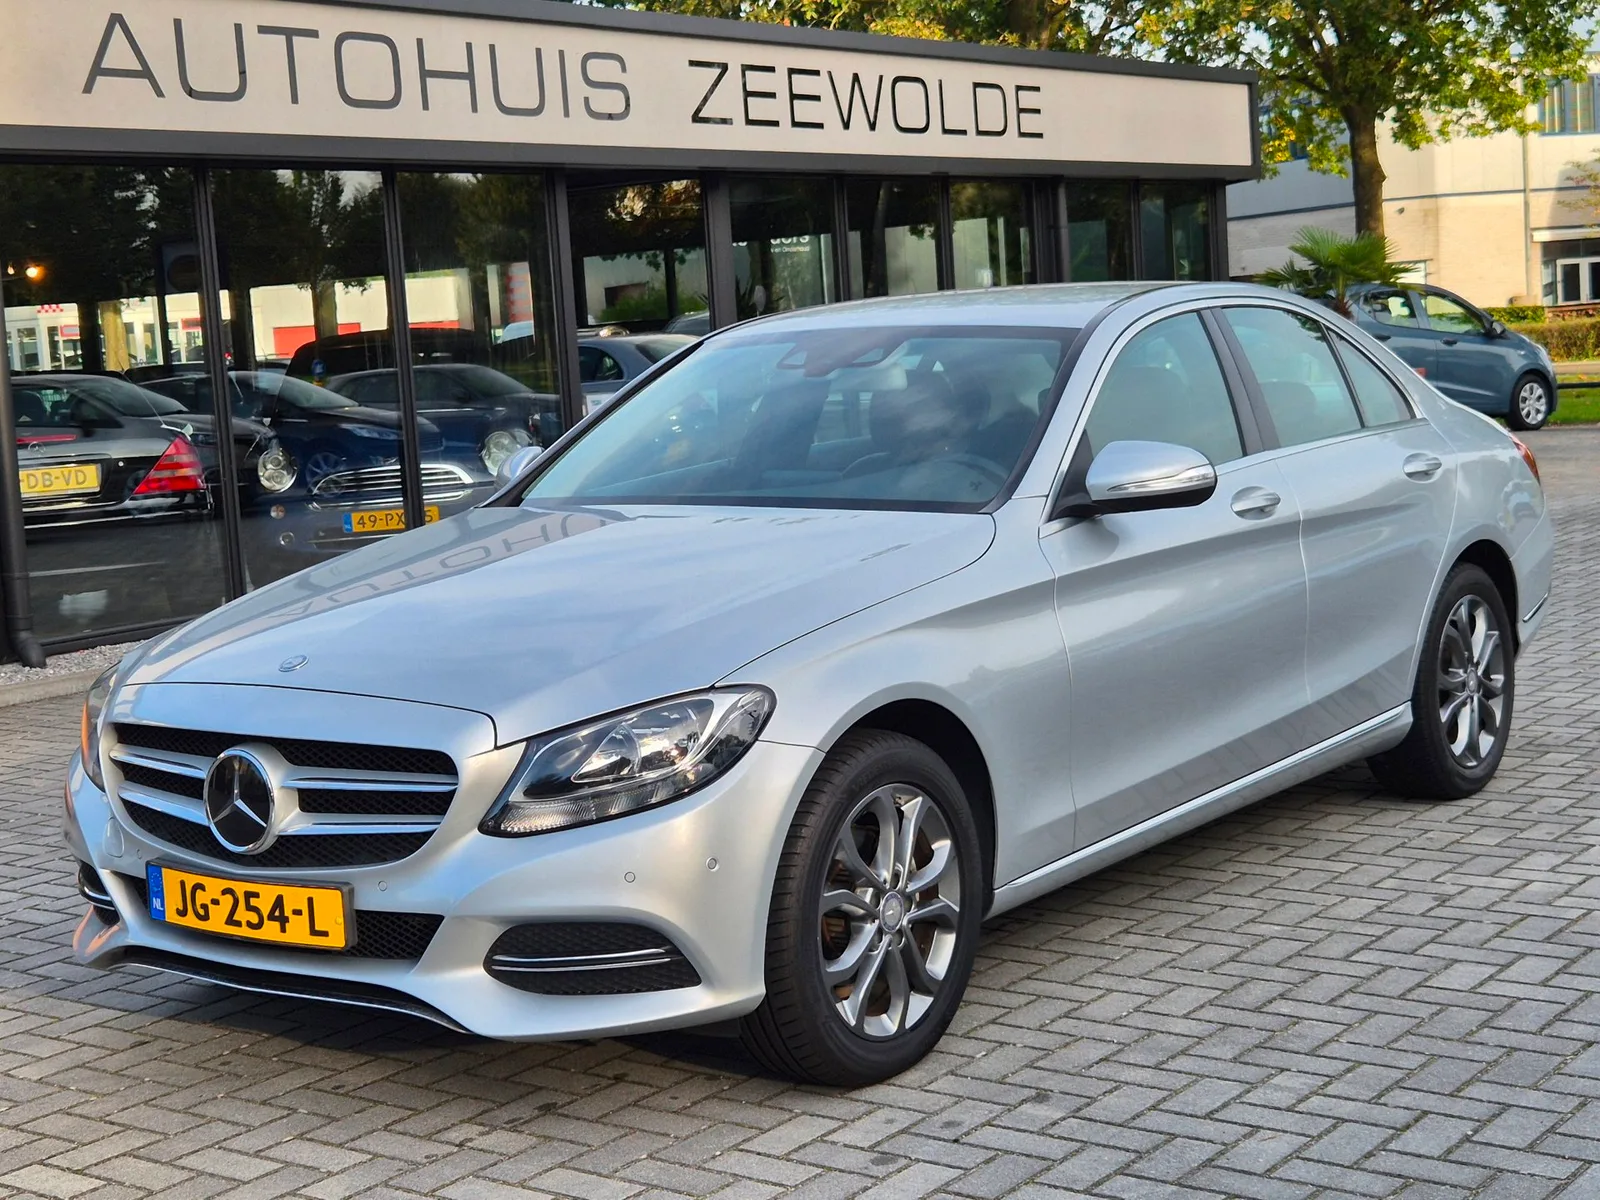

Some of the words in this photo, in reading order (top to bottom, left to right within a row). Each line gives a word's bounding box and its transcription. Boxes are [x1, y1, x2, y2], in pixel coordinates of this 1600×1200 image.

[82, 13, 631, 121] AUTOHUIS
[688, 59, 1044, 139] ZEEWOLDE
[153, 898, 164, 911] NL
[176, 879, 330, 938] JG-254-L
